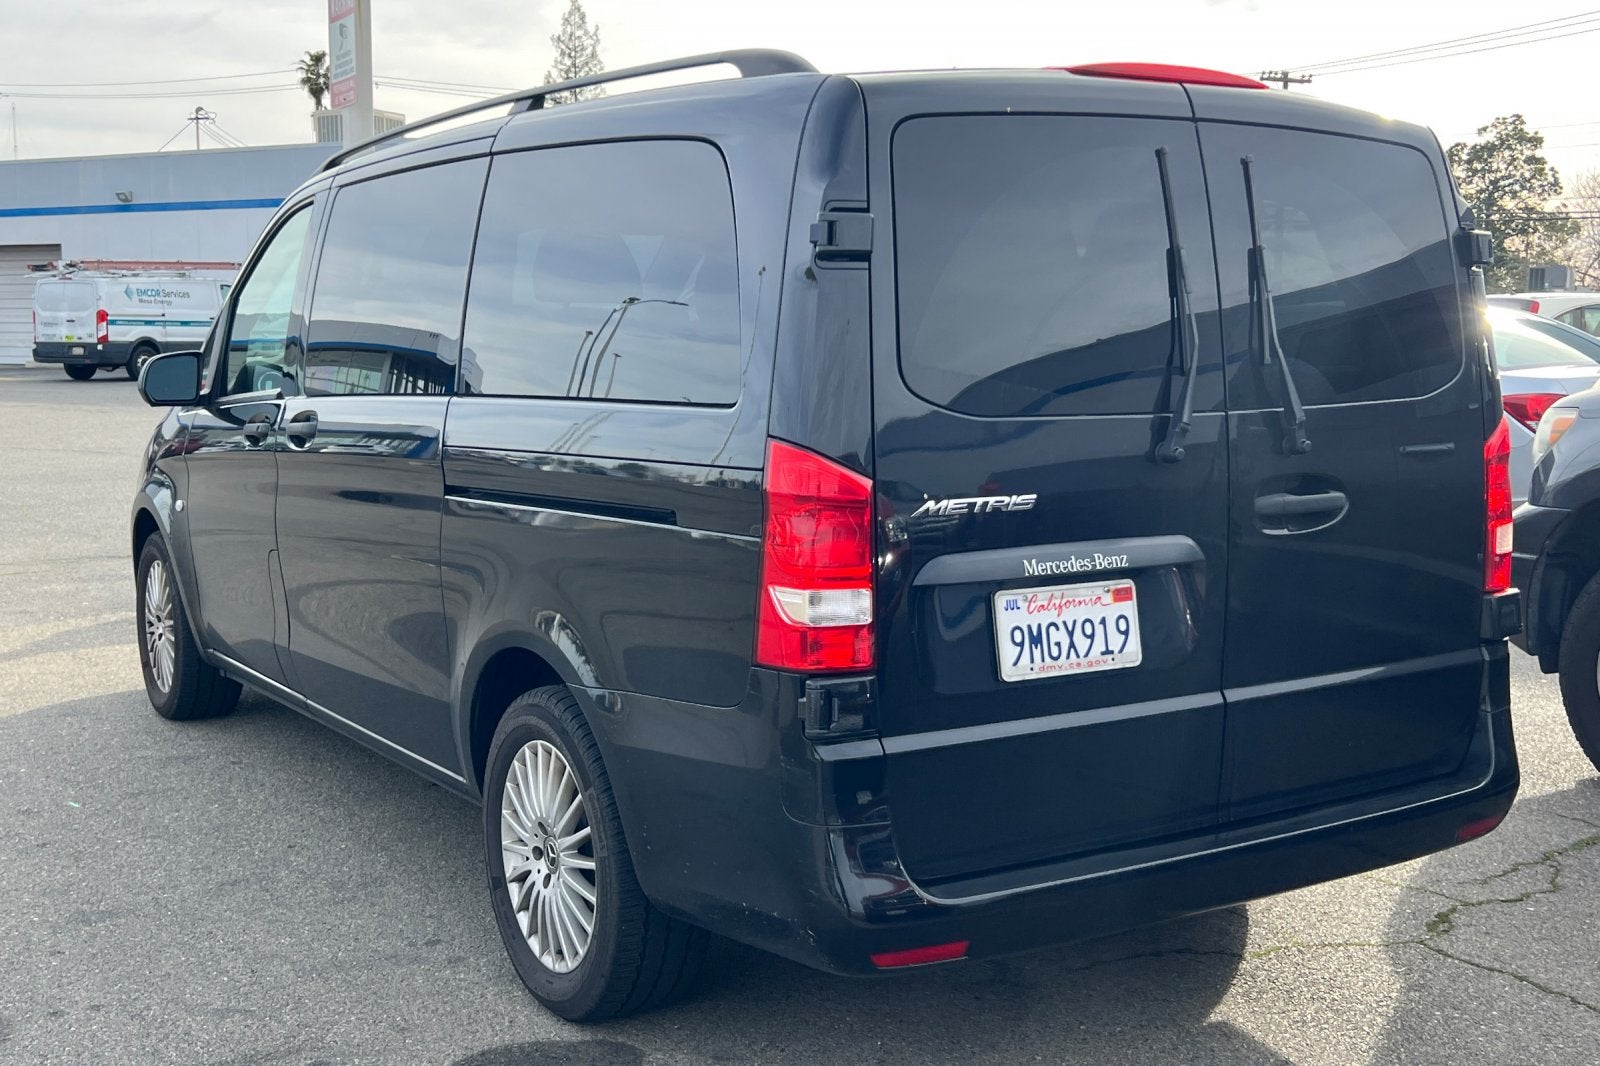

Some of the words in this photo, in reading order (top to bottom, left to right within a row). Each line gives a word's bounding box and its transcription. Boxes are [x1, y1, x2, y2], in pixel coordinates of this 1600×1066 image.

[136, 288, 160, 297] EMCOR
[161, 289, 190, 299] Services
[153, 298, 173, 306] Energy
[910, 493, 1037, 518] METRIS
[1022, 553, 1129, 577] Mercedes-Benz
[1004, 598, 1020, 612] JUL
[1026, 594, 1111, 618] California
[1009, 613, 1131, 668] 9MGX919
[1038, 656, 1109, 673] dmv.ca.gov
